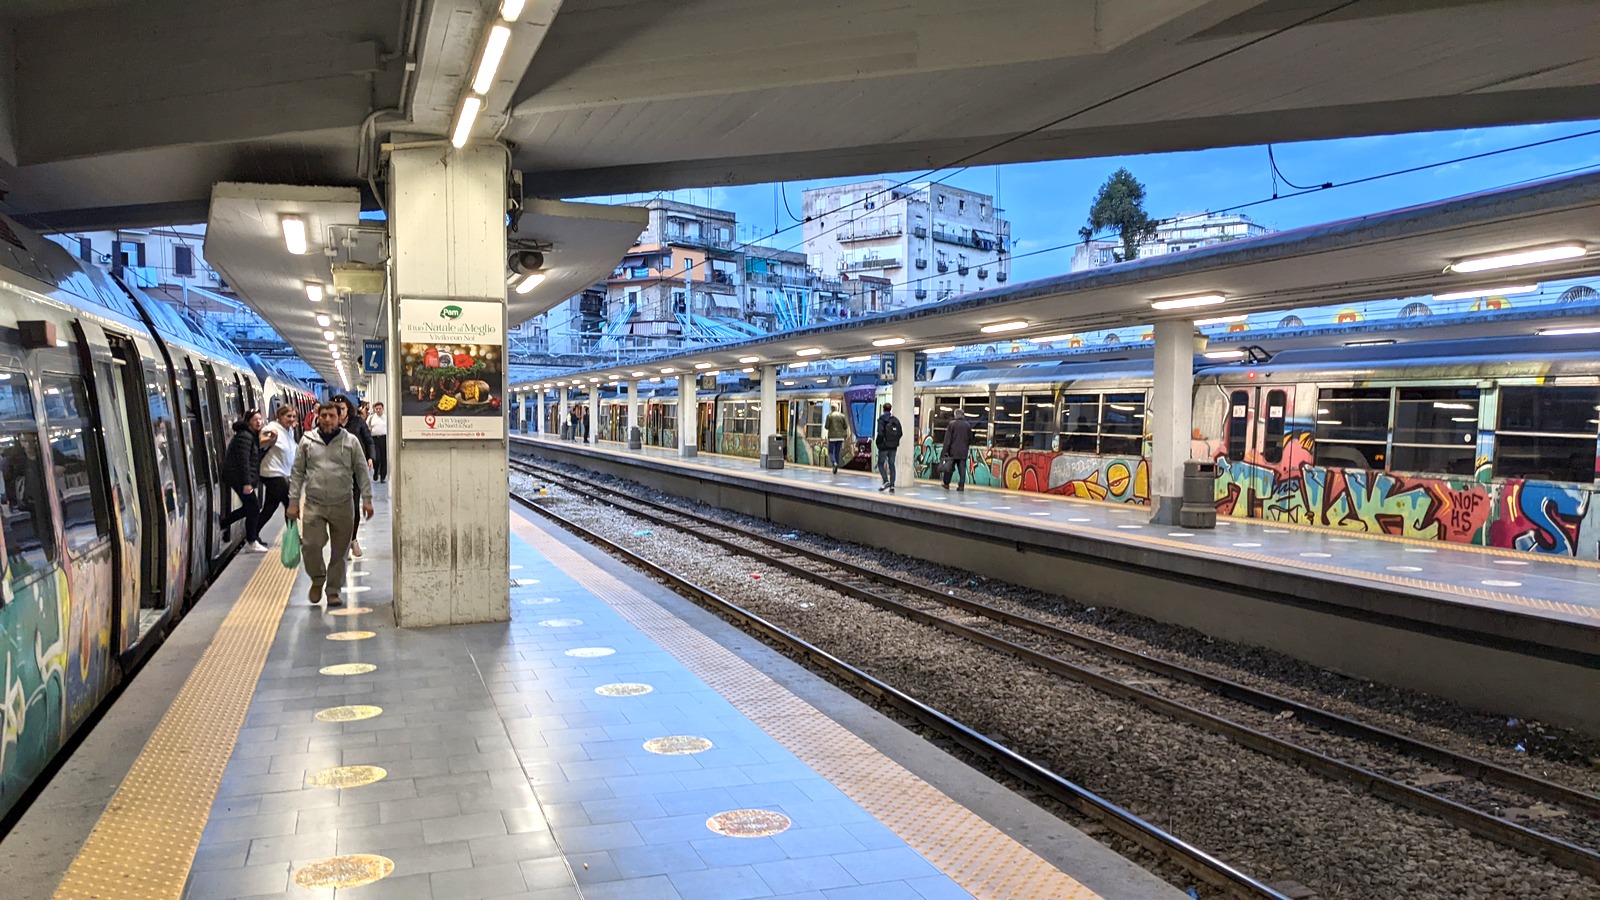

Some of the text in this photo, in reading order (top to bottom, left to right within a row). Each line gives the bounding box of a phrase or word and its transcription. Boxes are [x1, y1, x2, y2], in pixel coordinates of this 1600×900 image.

[443, 308, 459, 316] Pam
[412, 324, 424, 332] tuo
[423, 321, 456, 332] Natale
[463, 322, 496, 336] Meglio
[369, 350, 379, 369] 4
[885, 361, 892, 375] 6
[916, 361, 922, 377] 7
[1448, 491, 1483, 513] WOF
[1450, 508, 1472, 532] HS
